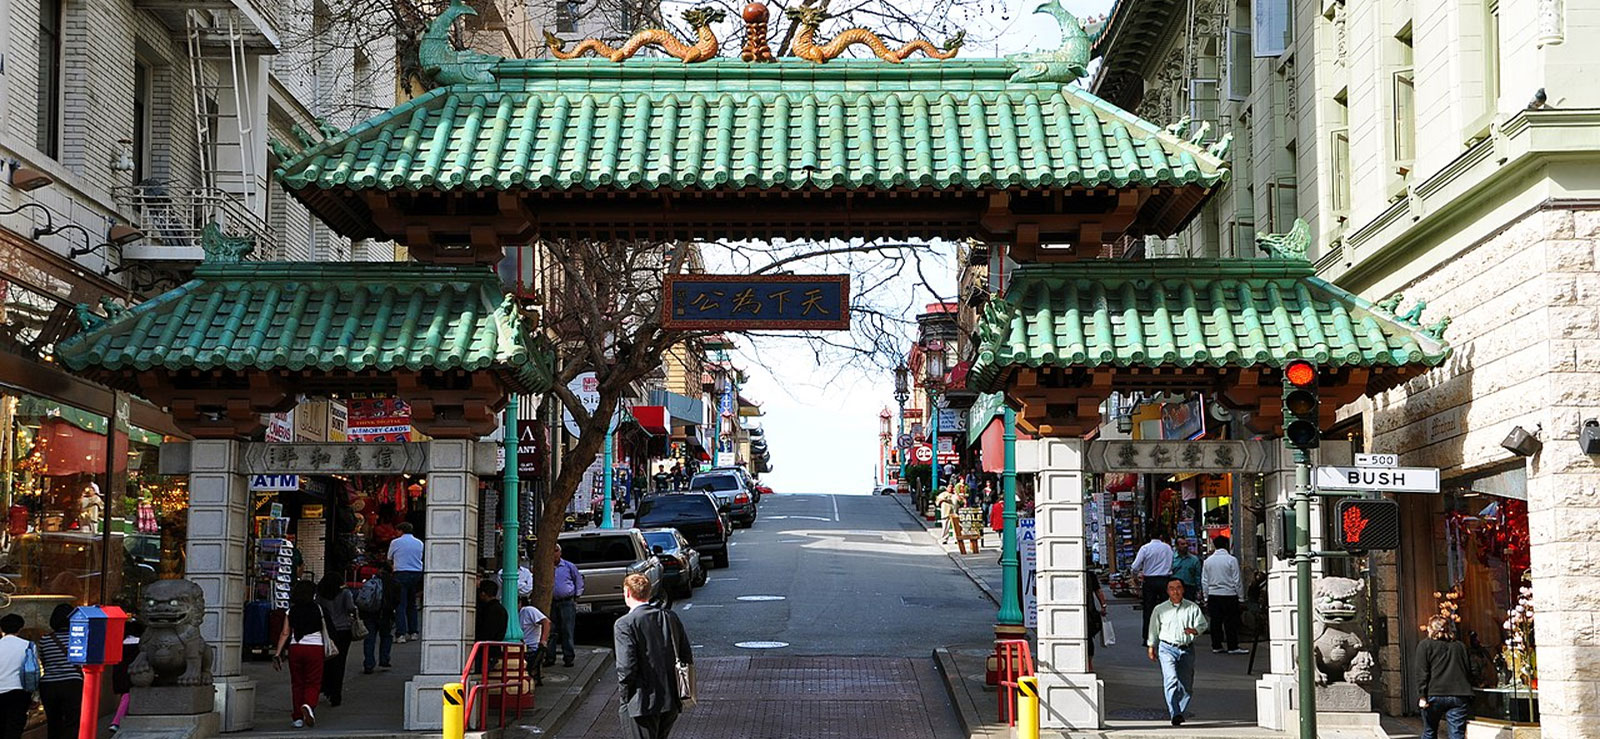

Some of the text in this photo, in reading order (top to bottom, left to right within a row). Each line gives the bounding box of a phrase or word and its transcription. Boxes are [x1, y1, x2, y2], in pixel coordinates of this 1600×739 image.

[1371, 455, 1394, 466] 500
[253, 475, 297, 487] ATM
[1347, 471, 1405, 486] BUSH
[959, 513, 983, 521] SALE
